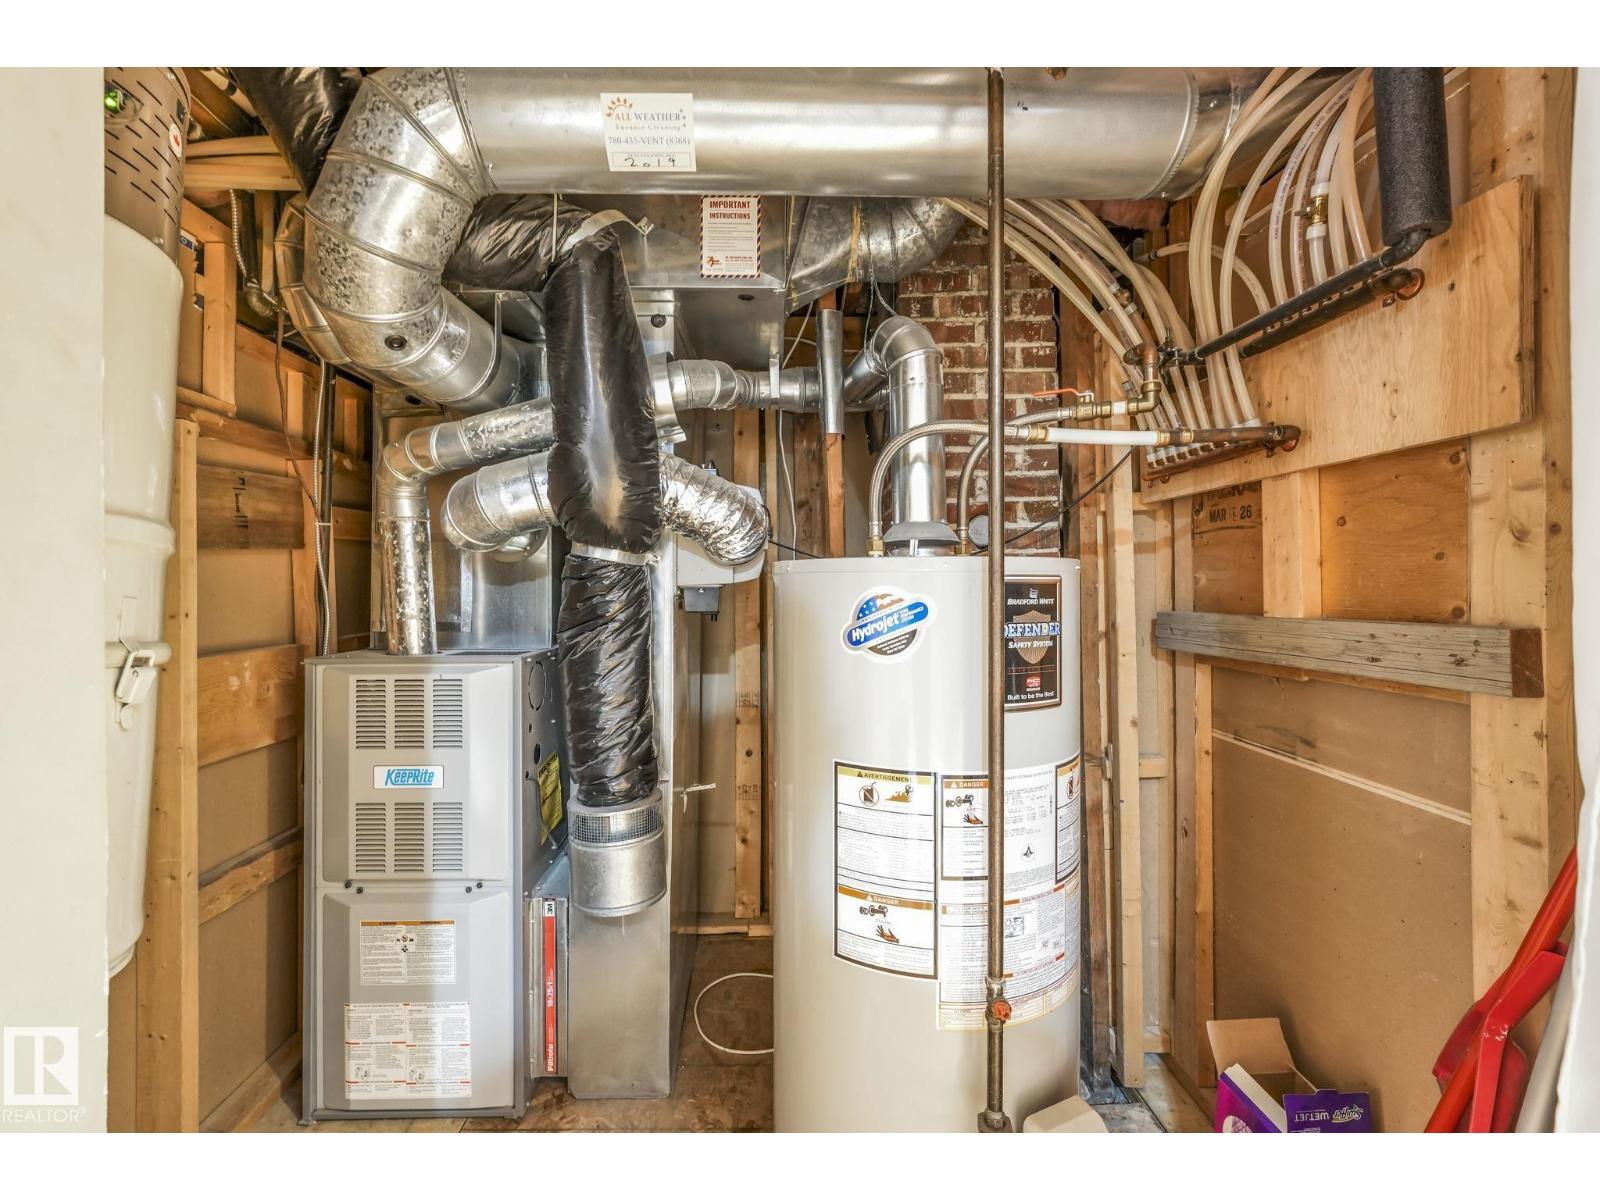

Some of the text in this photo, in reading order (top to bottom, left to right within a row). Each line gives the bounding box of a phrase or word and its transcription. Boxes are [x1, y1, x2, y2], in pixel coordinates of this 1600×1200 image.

[615, 112, 681, 121] ALL WEATHER
[624, 157, 676, 168] 2019
[709, 201, 751, 209] IMPORTANT
[1209, 508, 1227, 524] MAR
[1240, 505, 1253, 520] 26
[851, 612, 900, 643] Hydrojet
[1008, 640, 1054, 649] SAFETY SYSTEM
[547, 903, 553, 915] 3M
[1295, 1112, 1330, 1122] WETJET
